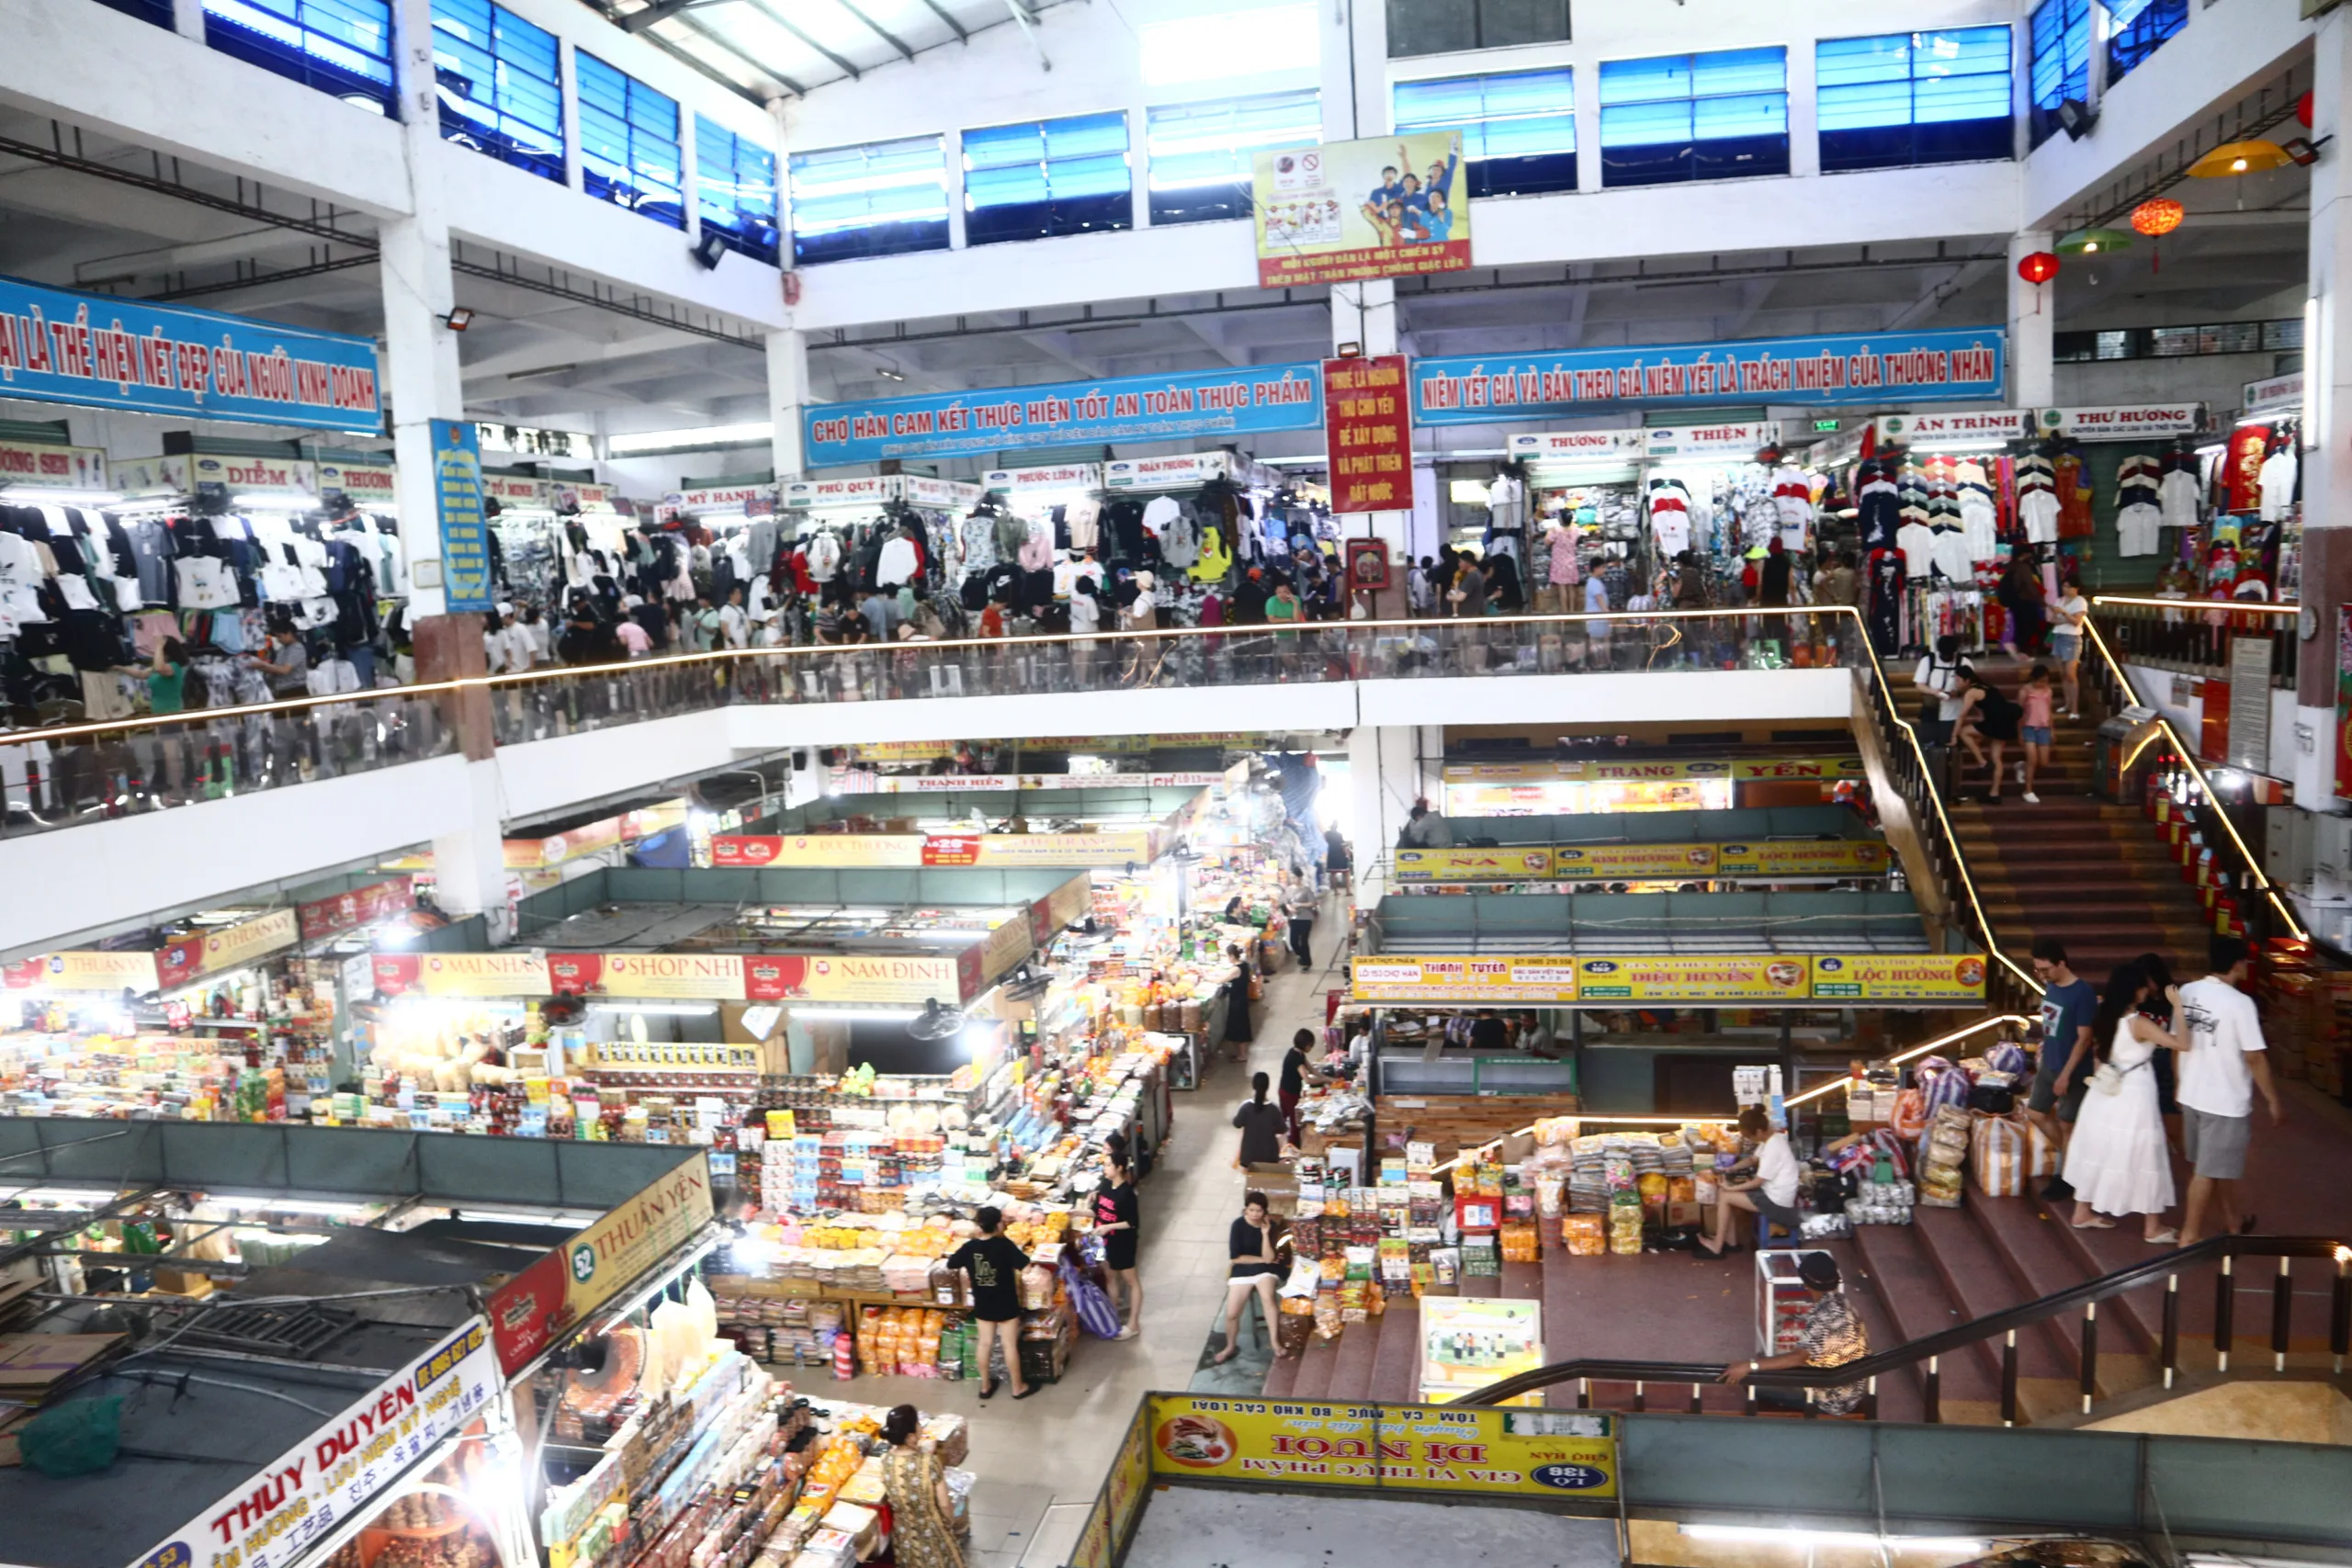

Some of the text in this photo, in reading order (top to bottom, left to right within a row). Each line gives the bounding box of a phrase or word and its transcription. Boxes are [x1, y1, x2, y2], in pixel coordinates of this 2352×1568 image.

[19, 304, 53, 374] LÀ
[48, 303, 95, 379] THỂ
[92, 319, 141, 395] HIỆN
[175, 341, 209, 404] ĐẸP
[213, 333, 249, 398] CỦA
[247, 344, 296, 403] NGƯỜI
[294, 358, 331, 407] KINH
[329, 364, 378, 412] DOANH
[1421, 342, 1995, 410] NIÊM YẾT GIÁ VÀ BÁN THEO GIÁ NIÊM YẾT LÀ TRÁCH NHIỆM CỦA THƯƠNG NHÂN
[812, 370, 1311, 446] CHỢ HÀN CAM KẾT THỰC HIỆN TỐT AN TOÀN THỰC PHẨM
[2076, 408, 2188, 423] THƯ HƯƠNG
[1549, 434, 1608, 447] THƯƠNG
[1690, 425, 1747, 441] THIỆN
[1597, 765, 1675, 777] TRANG
[1746, 761, 1823, 777] YẾN
[449, 958, 482, 974] MAI
[628, 957, 689, 976] SHOP
[695, 957, 739, 976] NHI
[842, 961, 887, 979] NAM
[1853, 967, 1888, 983] LỘC
[573, 1248, 594, 1279] 52
[1192, 1400, 1228, 1413] LOẠI
[1235, 1403, 1266, 1415] CÁC
[1311, 1406, 1331, 1418] BÒ
[1348, 1407, 1385, 1420] MỰC
[1439, 1412, 1477, 1424] TÔM
[1414, 1424, 1480, 1440] Chuyên
[1271, 1434, 1488, 1467] DÌ NUÔI
[1571, 1452, 1610, 1462] CHỢ
[1240, 1458, 1522, 1483] GIA VỊ THỰC PHẨM
[1553, 1477, 1585, 1486] LÔ
[243, 1498, 311, 1558] HƯƠNG
[284, 1502, 335, 1557] 工艺品
